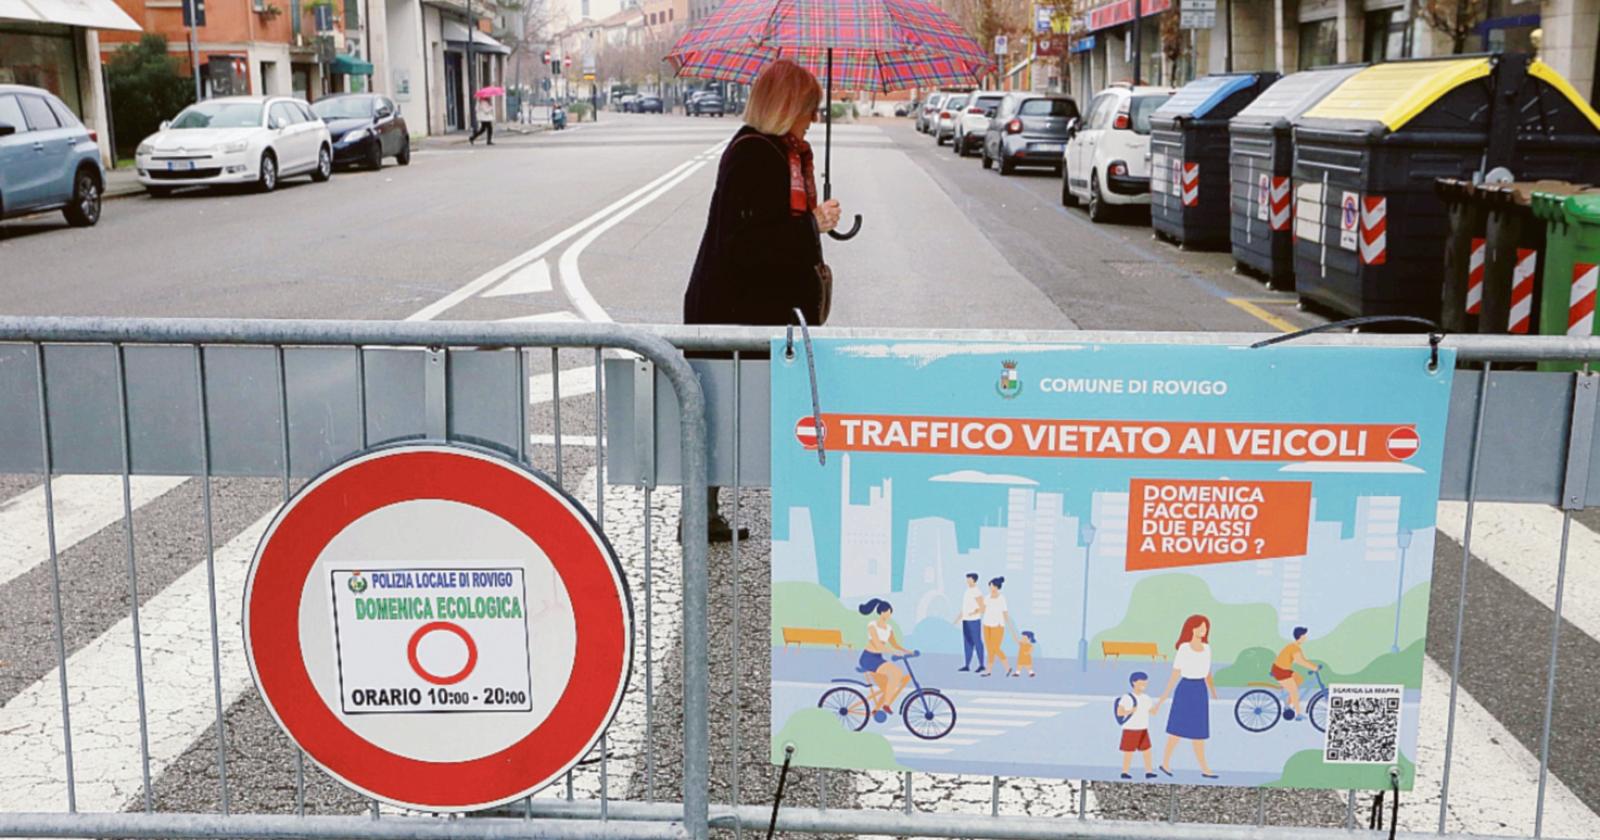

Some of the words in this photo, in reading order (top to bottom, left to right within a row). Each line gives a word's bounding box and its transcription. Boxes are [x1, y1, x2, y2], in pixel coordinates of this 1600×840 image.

[1039, 378, 1123, 395] COMUNE
[1128, 379, 1148, 395] DI
[1152, 380, 1228, 397] ROVIGO
[840, 419, 1014, 451] TRAFFICO
[1022, 423, 1171, 454] VIETATO
[1179, 428, 1216, 455] AI
[1225, 429, 1367, 457] VEICOLI
[1144, 485, 1264, 503] DOMENICA
[1143, 503, 1258, 520] FACCIAMO
[1142, 520, 1186, 537] DUE
[1191, 521, 1251, 537] PASSI
[1140, 537, 1157, 553] A
[1162, 537, 1248, 554] ROVIGO
[1254, 538, 1265, 554] ?
[372, 573, 414, 588] POLIZIA
[416, 573, 456, 588] LOCALE
[459, 573, 470, 587] DI
[472, 572, 512, 587] ROVIGO
[355, 598, 433, 620] DOMENICA
[437, 597, 522, 619] ECOLOGICA
[352, 688, 421, 706] ORARIO
[428, 688, 469, 705] 10:00
[484, 688, 526, 705] 20:00
